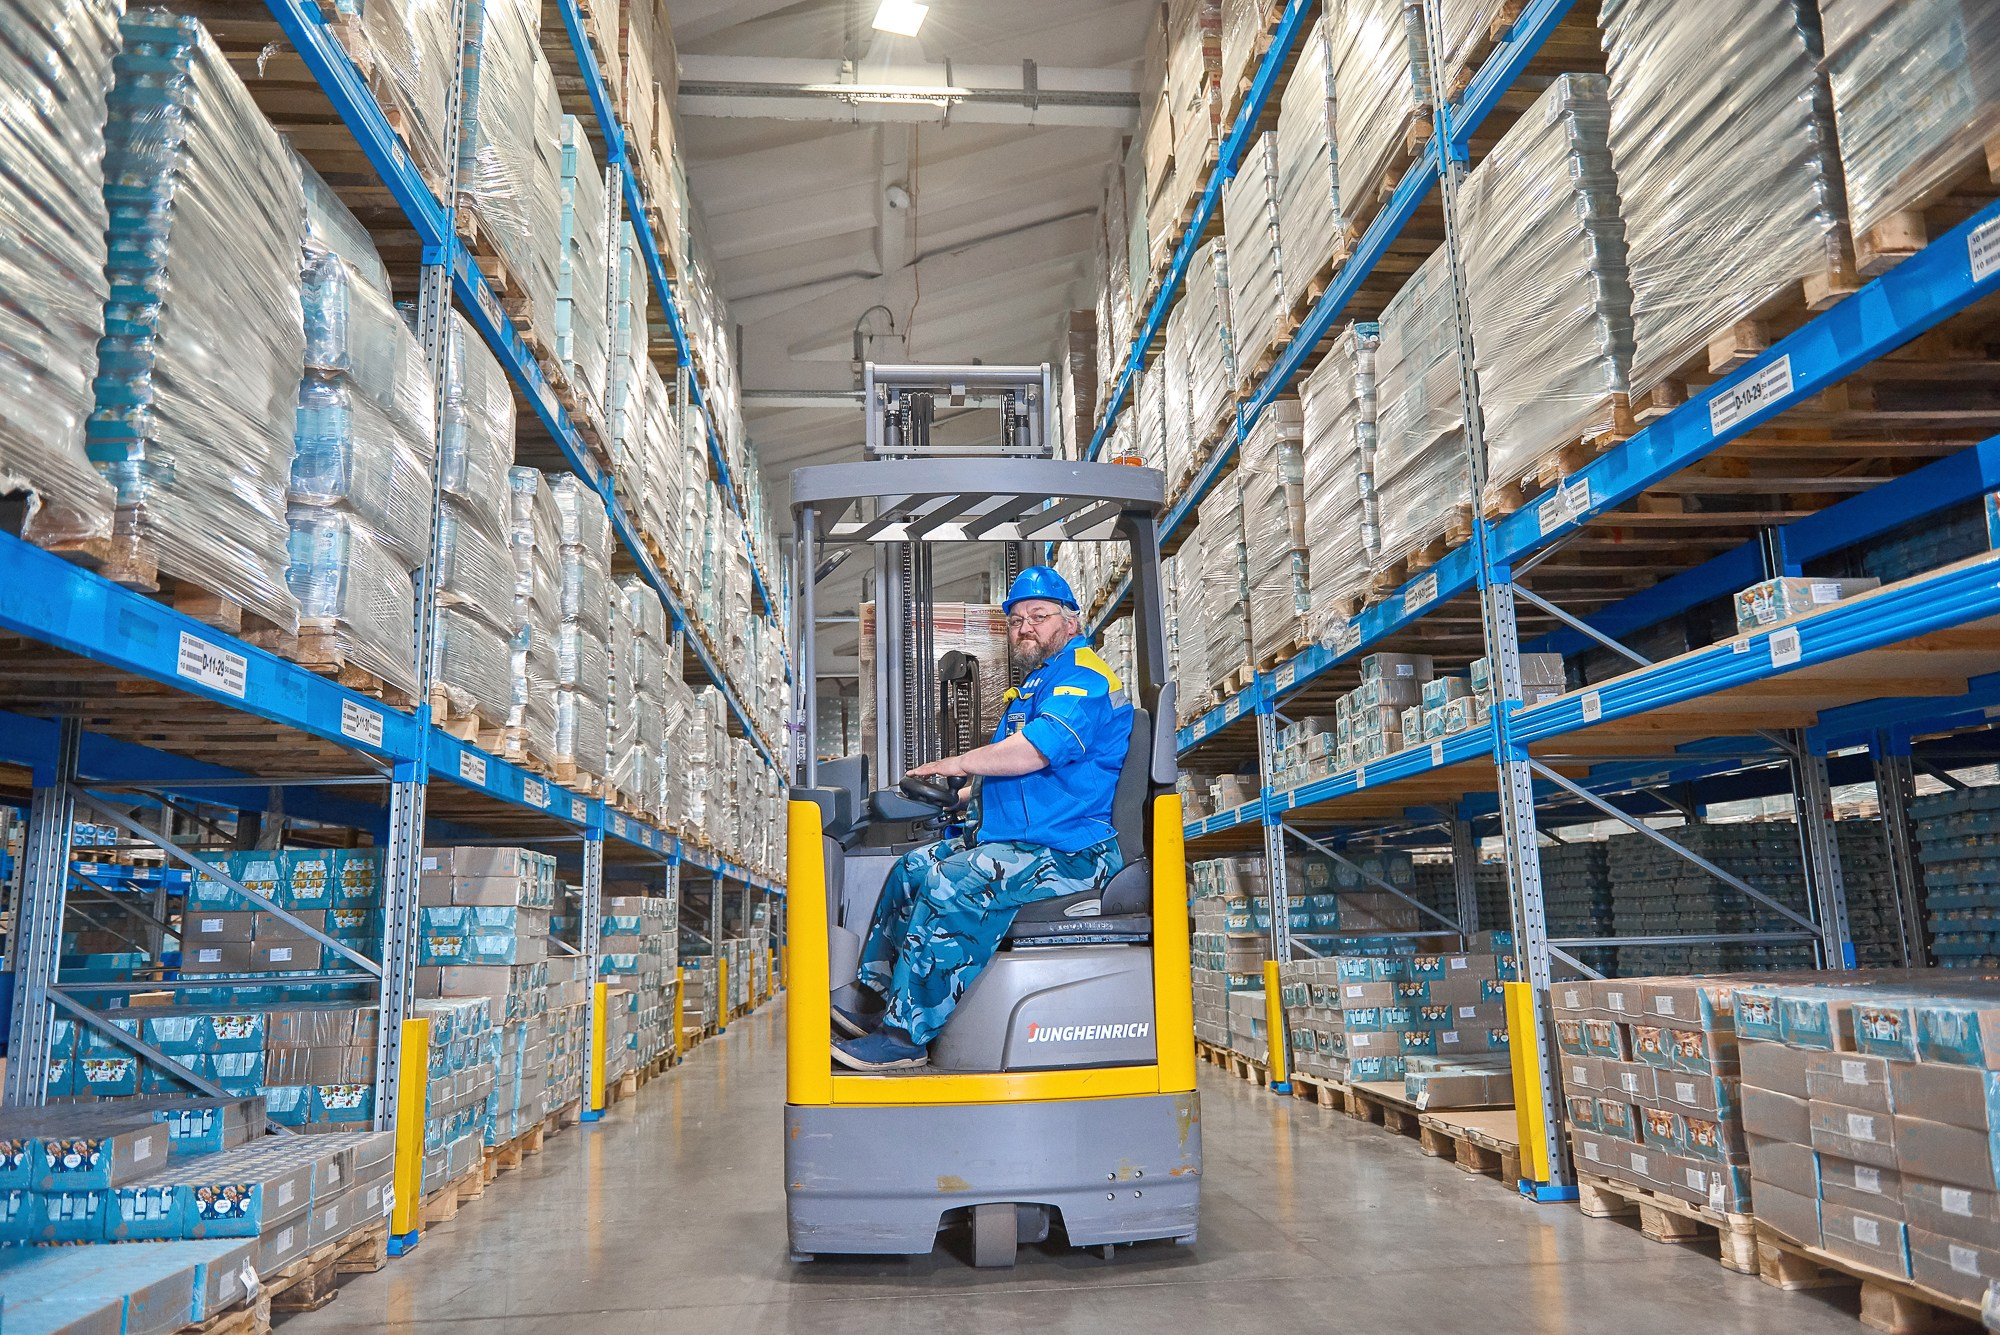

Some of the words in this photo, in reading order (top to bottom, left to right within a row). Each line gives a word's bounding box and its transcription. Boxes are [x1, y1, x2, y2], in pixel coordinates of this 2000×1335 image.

[1972, 235, 1980, 244] 30
[1974, 248, 1983, 258] 20
[1976, 261, 1985, 271] 10
[1735, 383, 1762, 410] D-10-29
[202, 653, 225, 677] D-11-29
[1027, 1022, 1149, 1043] JUNGHEINRICH
